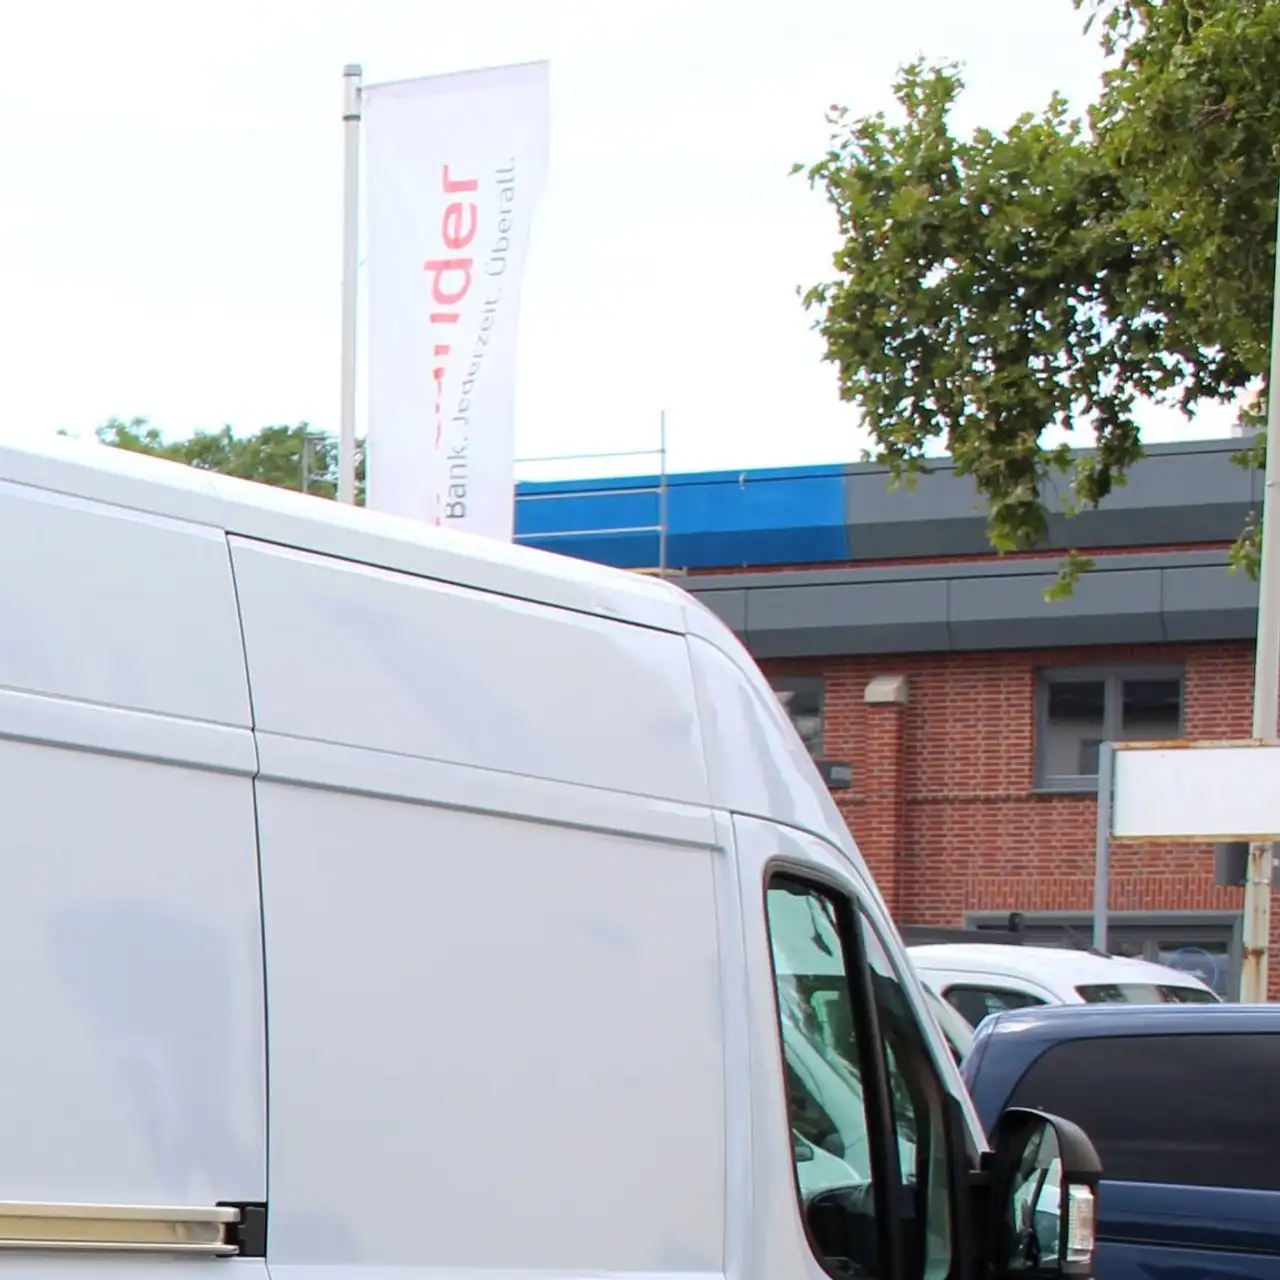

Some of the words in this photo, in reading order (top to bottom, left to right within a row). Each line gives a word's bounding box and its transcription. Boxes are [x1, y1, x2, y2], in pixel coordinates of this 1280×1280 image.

[483, 156, 516, 277] Überall.
[452, 286, 503, 425] Jederzeit.
[446, 436, 468, 519] Bank.
